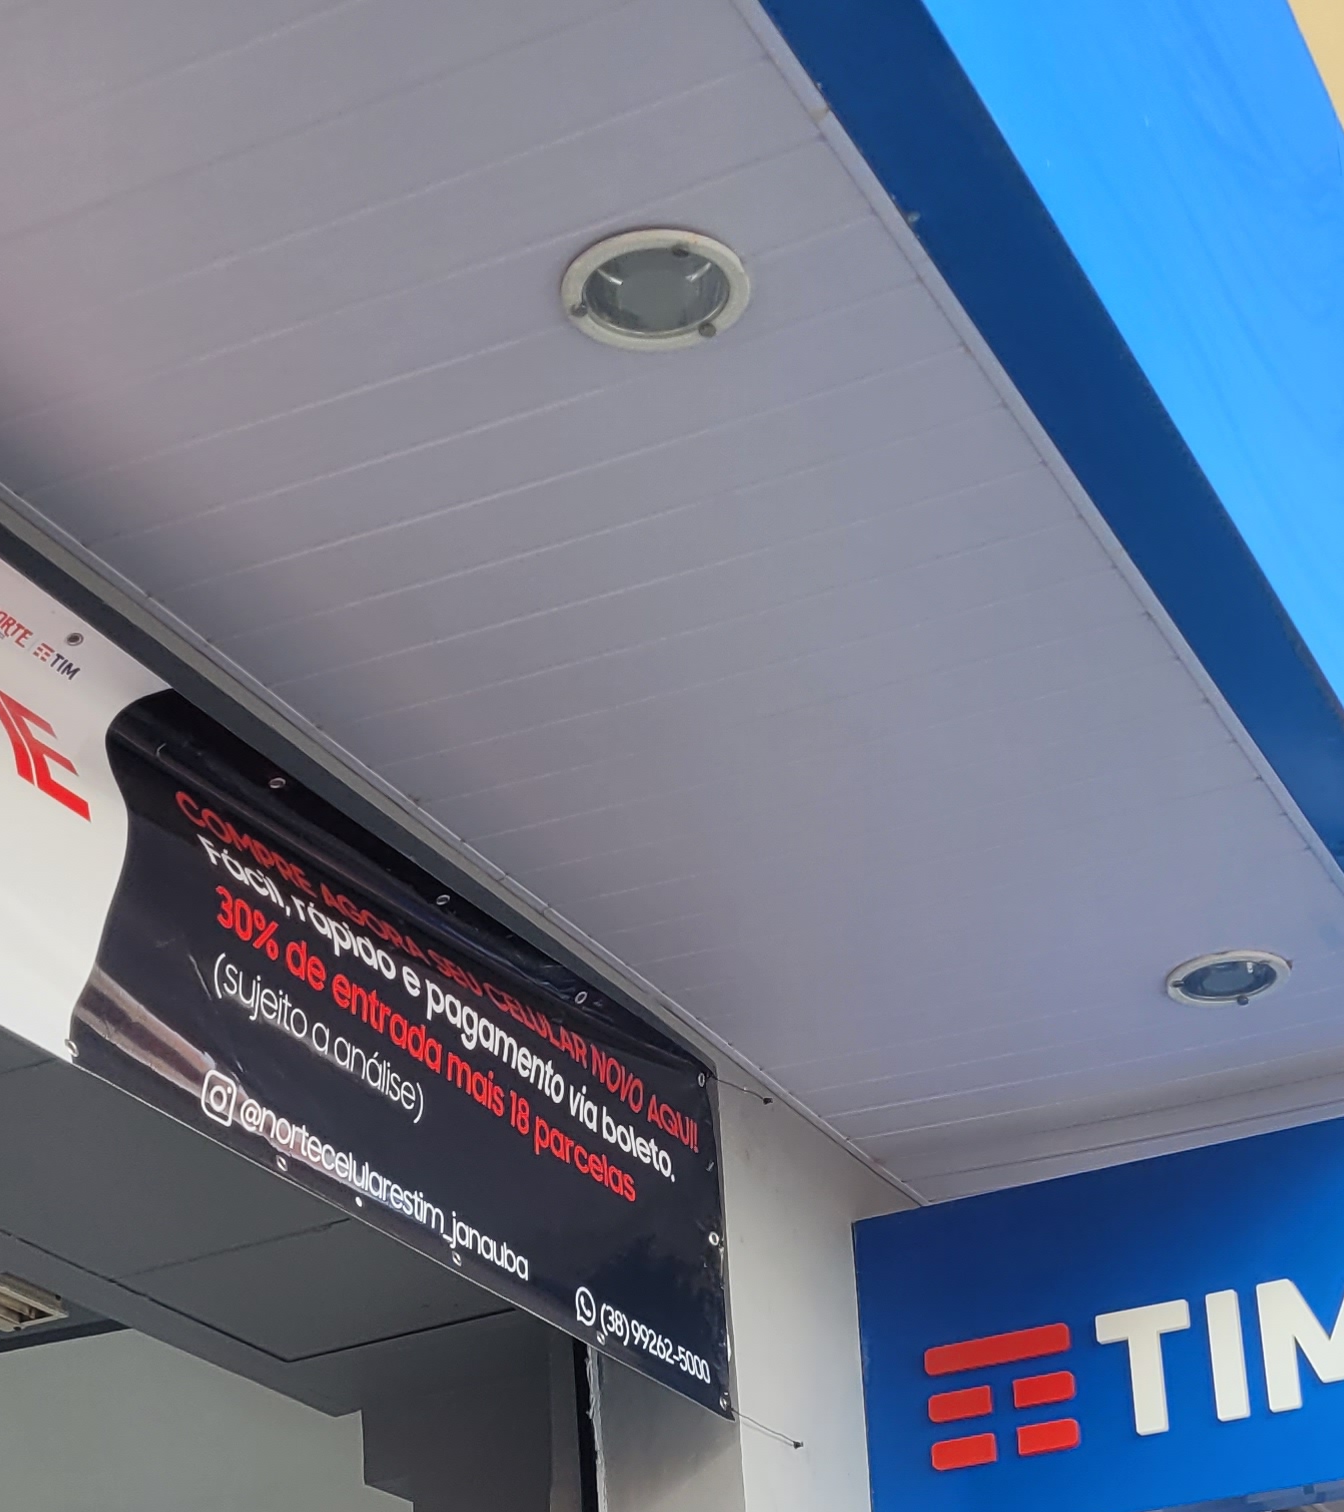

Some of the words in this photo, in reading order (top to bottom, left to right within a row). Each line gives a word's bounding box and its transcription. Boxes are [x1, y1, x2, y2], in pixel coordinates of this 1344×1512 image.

[50, 653, 81, 681] TIM
[175, 791, 318, 898] COMPRE
[320, 882, 432, 967] AGORA
[428, 949, 482, 997] SEU
[483, 982, 588, 1069] CELULAR
[590, 1043, 644, 1114] NOVO
[646, 1094, 699, 1154] AQUI!
[214, 952, 308, 1038] (sujeito
[312, 1022, 330, 1055] a
[334, 1037, 424, 1124] análise)
[216, 885, 279, 961] 30%
[285, 940, 326, 992] de
[332, 973, 443, 1074] entrada
[446, 1052, 504, 1118] mais
[510, 1090, 530, 1136] 18
[534, 1116, 637, 1203] parcelas
[290, 895, 396, 980] rápido
[402, 966, 421, 997] e
[425, 978, 565, 1104] pagamento
[569, 1085, 597, 1134] via
[602, 1112, 676, 1183] boleto.
[239, 1098, 530, 1282] @nortecelularestim_janauba
[601, 1303, 630, 1346] (38)
[631, 1319, 712, 1384] 99262-5000
